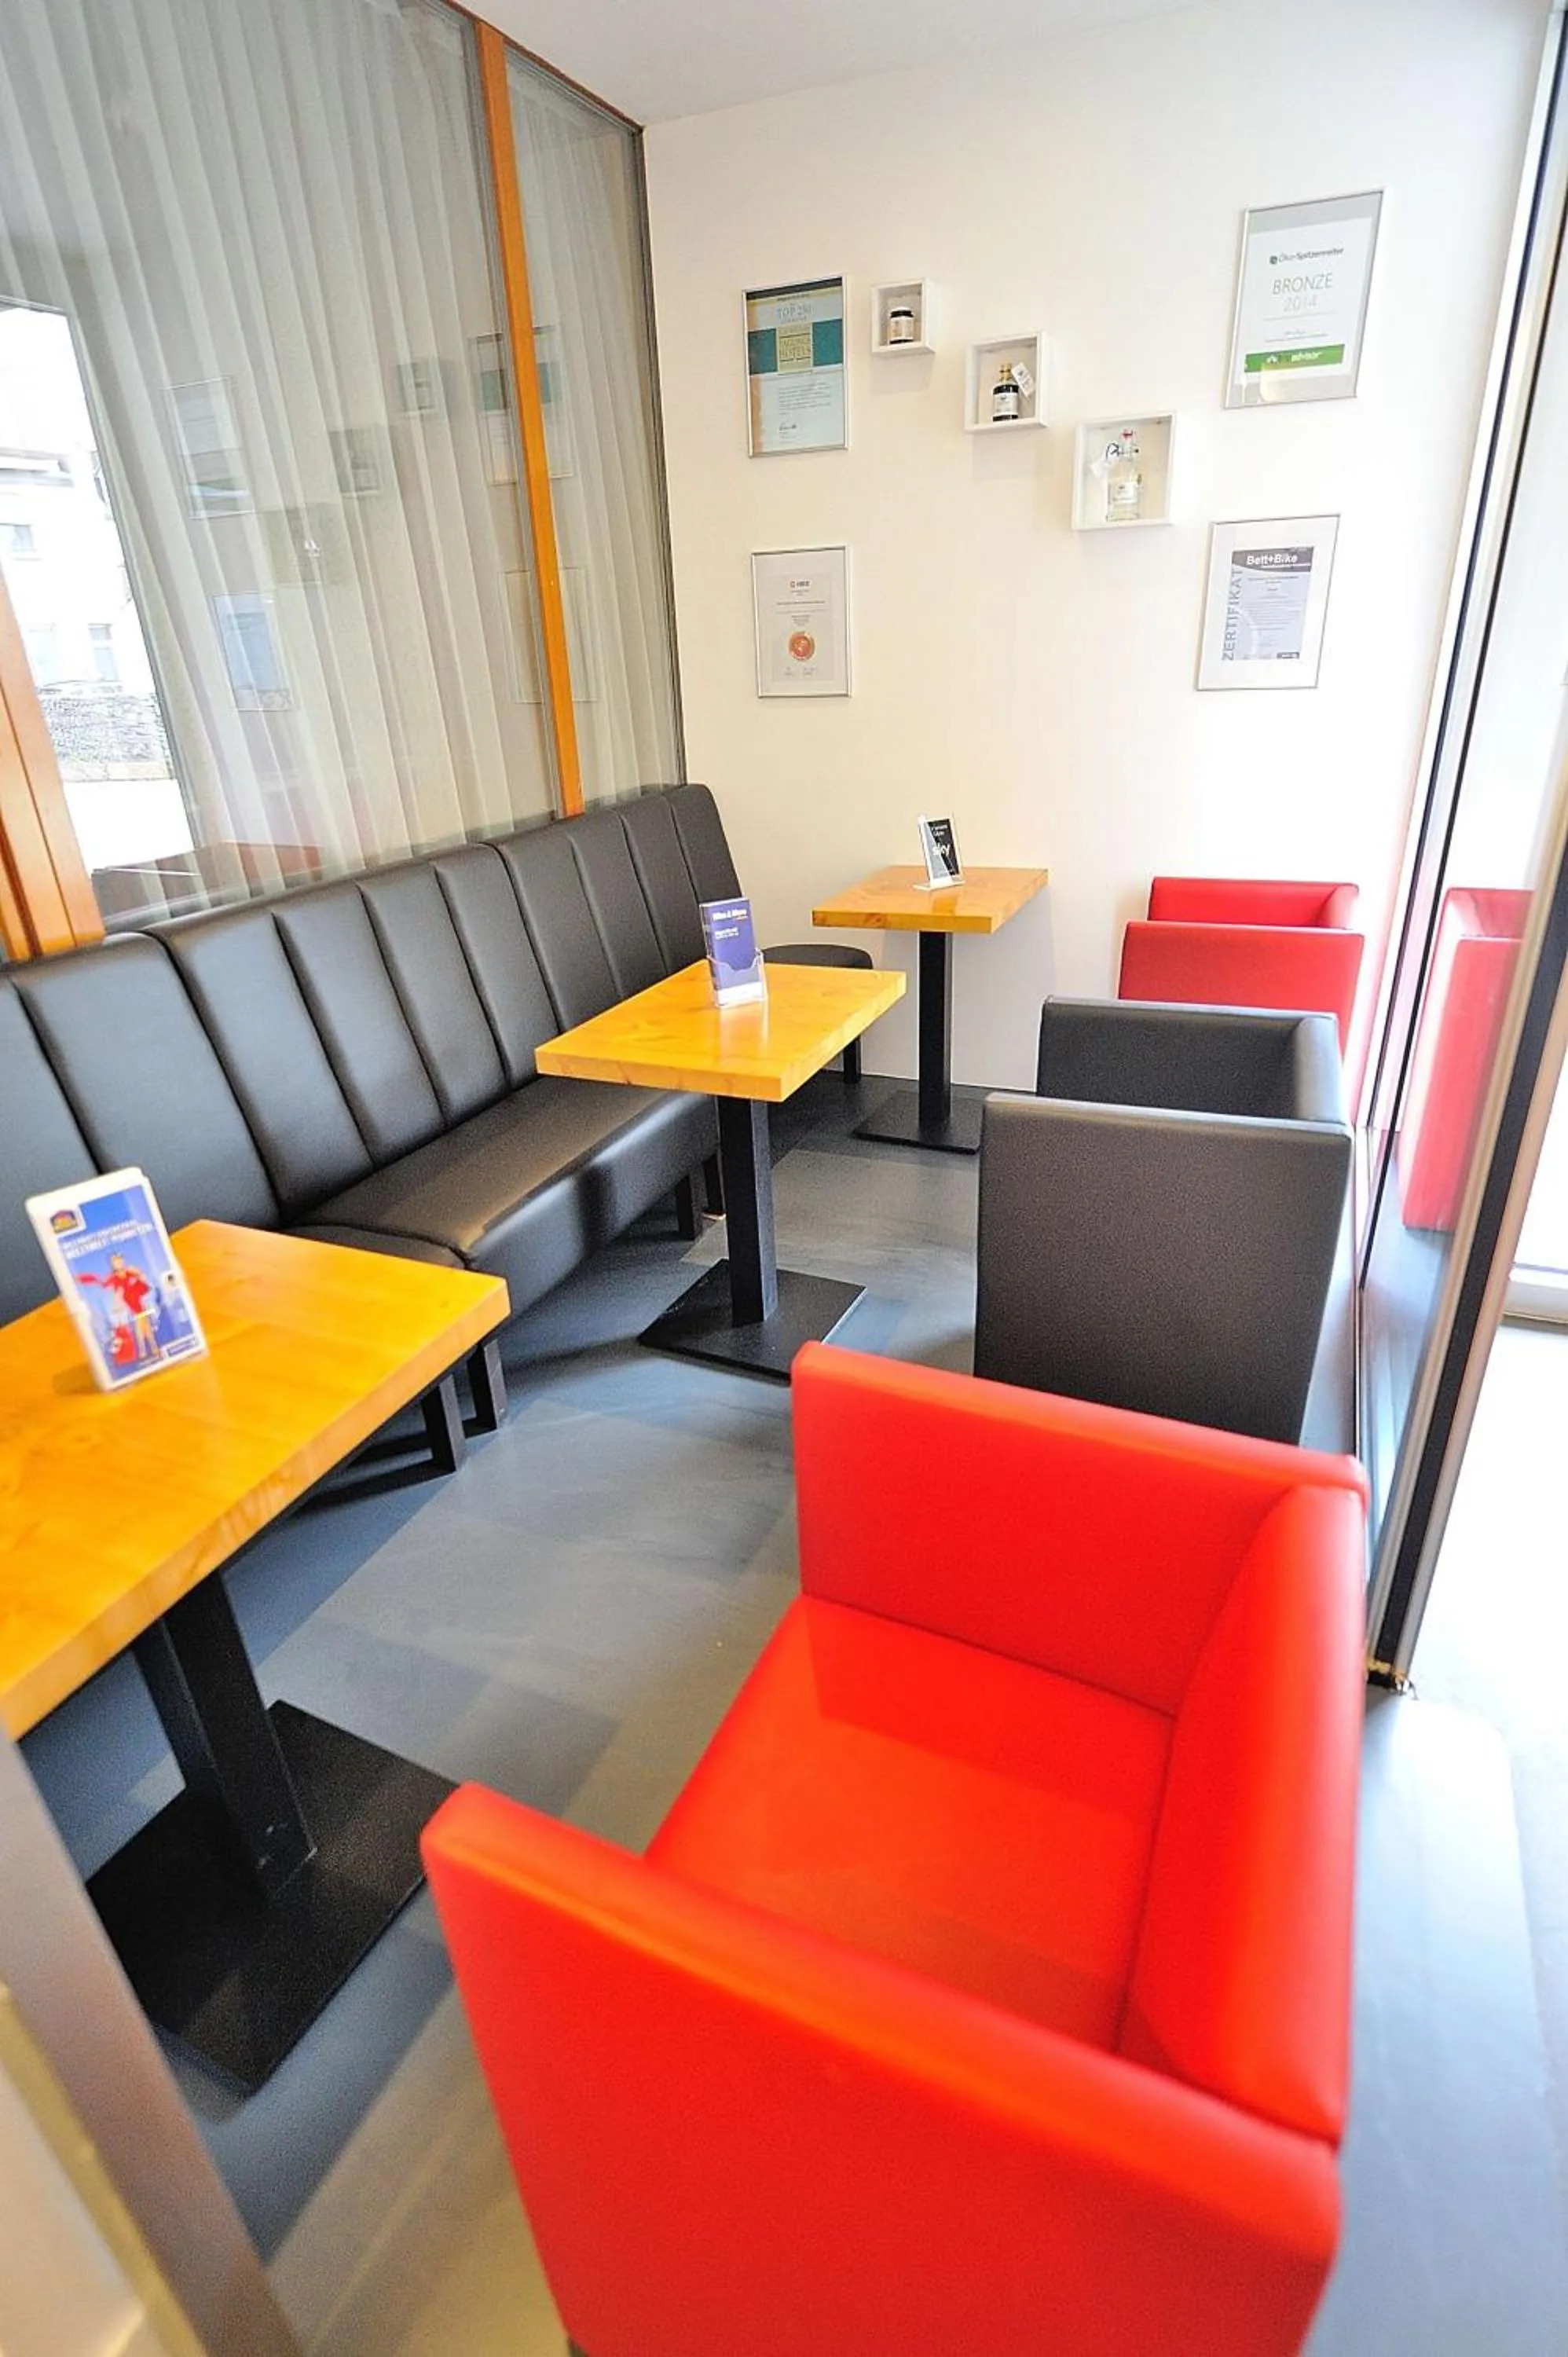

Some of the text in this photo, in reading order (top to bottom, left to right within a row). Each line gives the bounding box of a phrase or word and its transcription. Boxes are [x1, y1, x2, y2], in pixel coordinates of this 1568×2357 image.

[1272, 272, 1334, 295] BRONZE
[1283, 294, 1317, 312] 2014
[1246, 553, 1298, 565] Bett+Bike
[1222, 568, 1243, 661] ZERTIFIKAT
